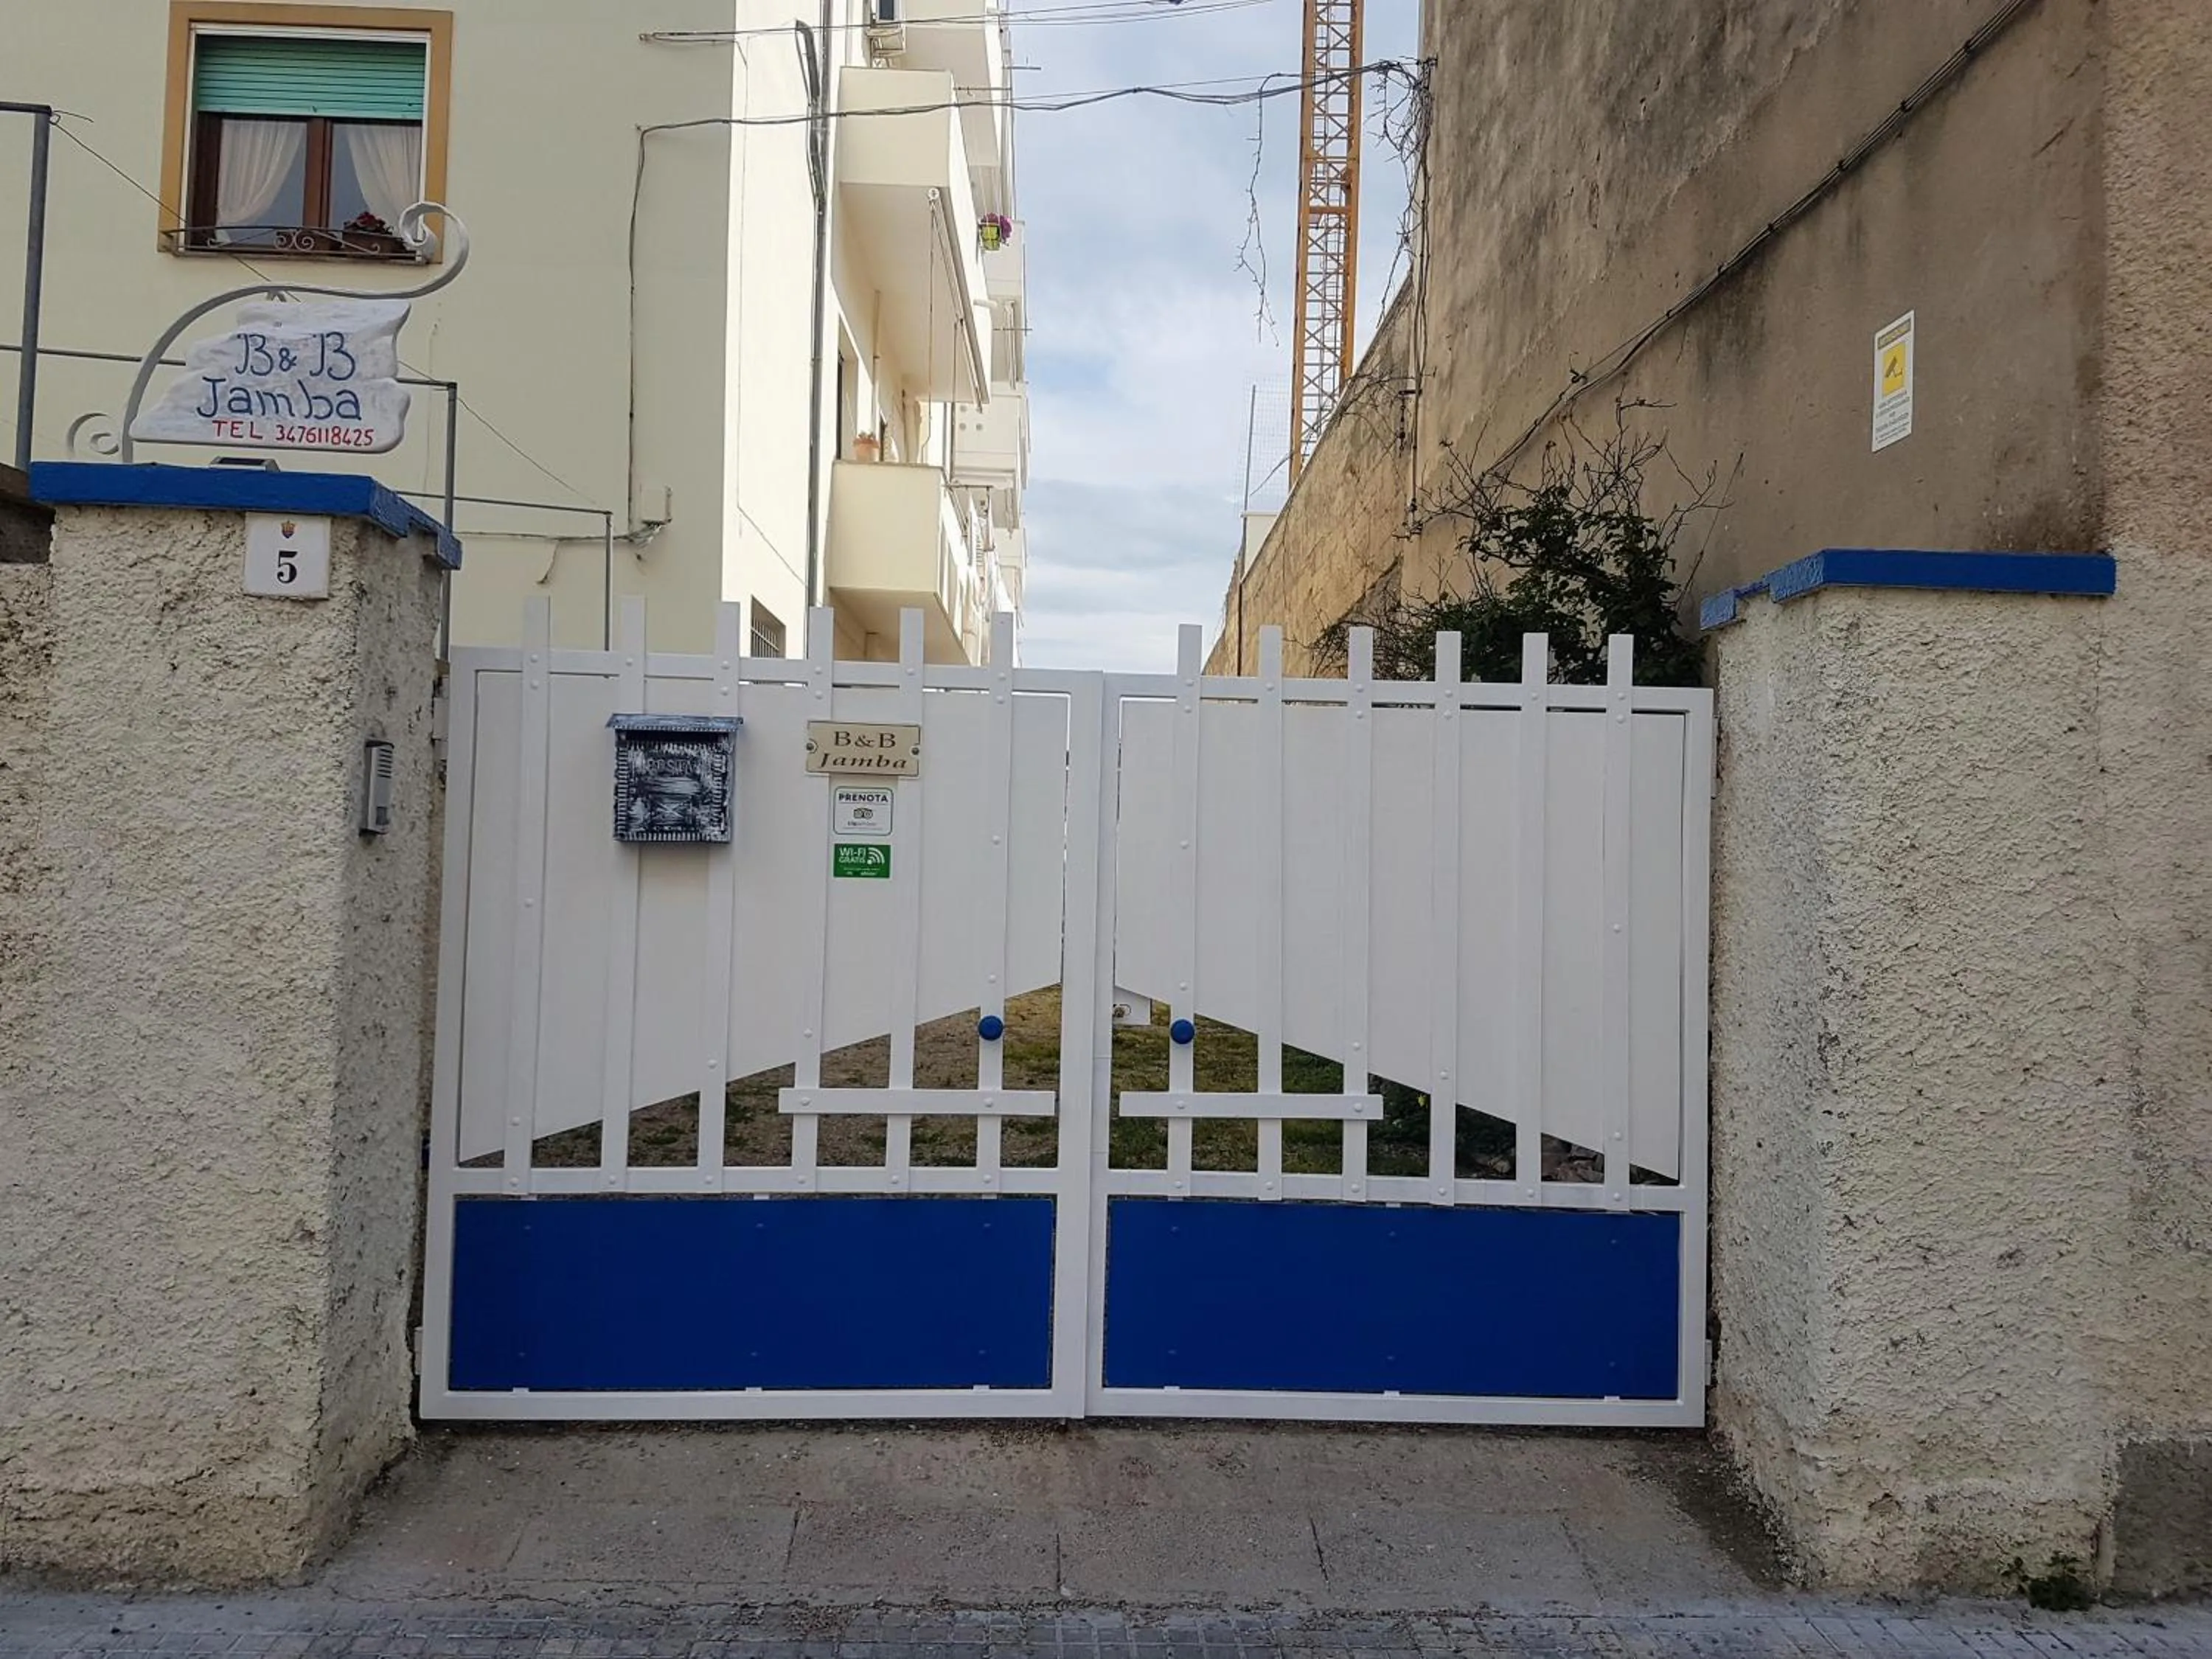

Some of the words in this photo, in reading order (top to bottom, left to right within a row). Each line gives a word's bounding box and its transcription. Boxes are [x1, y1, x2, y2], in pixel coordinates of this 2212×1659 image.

[196, 376, 361, 420] Jamba
[212, 420, 262, 439] TEL
[275, 425, 374, 446] 3476118425
[276, 550, 298, 584] 5
[834, 731, 897, 748] B&B
[819, 753, 907, 769] Jamba
[838, 793, 888, 803] PRENOTA
